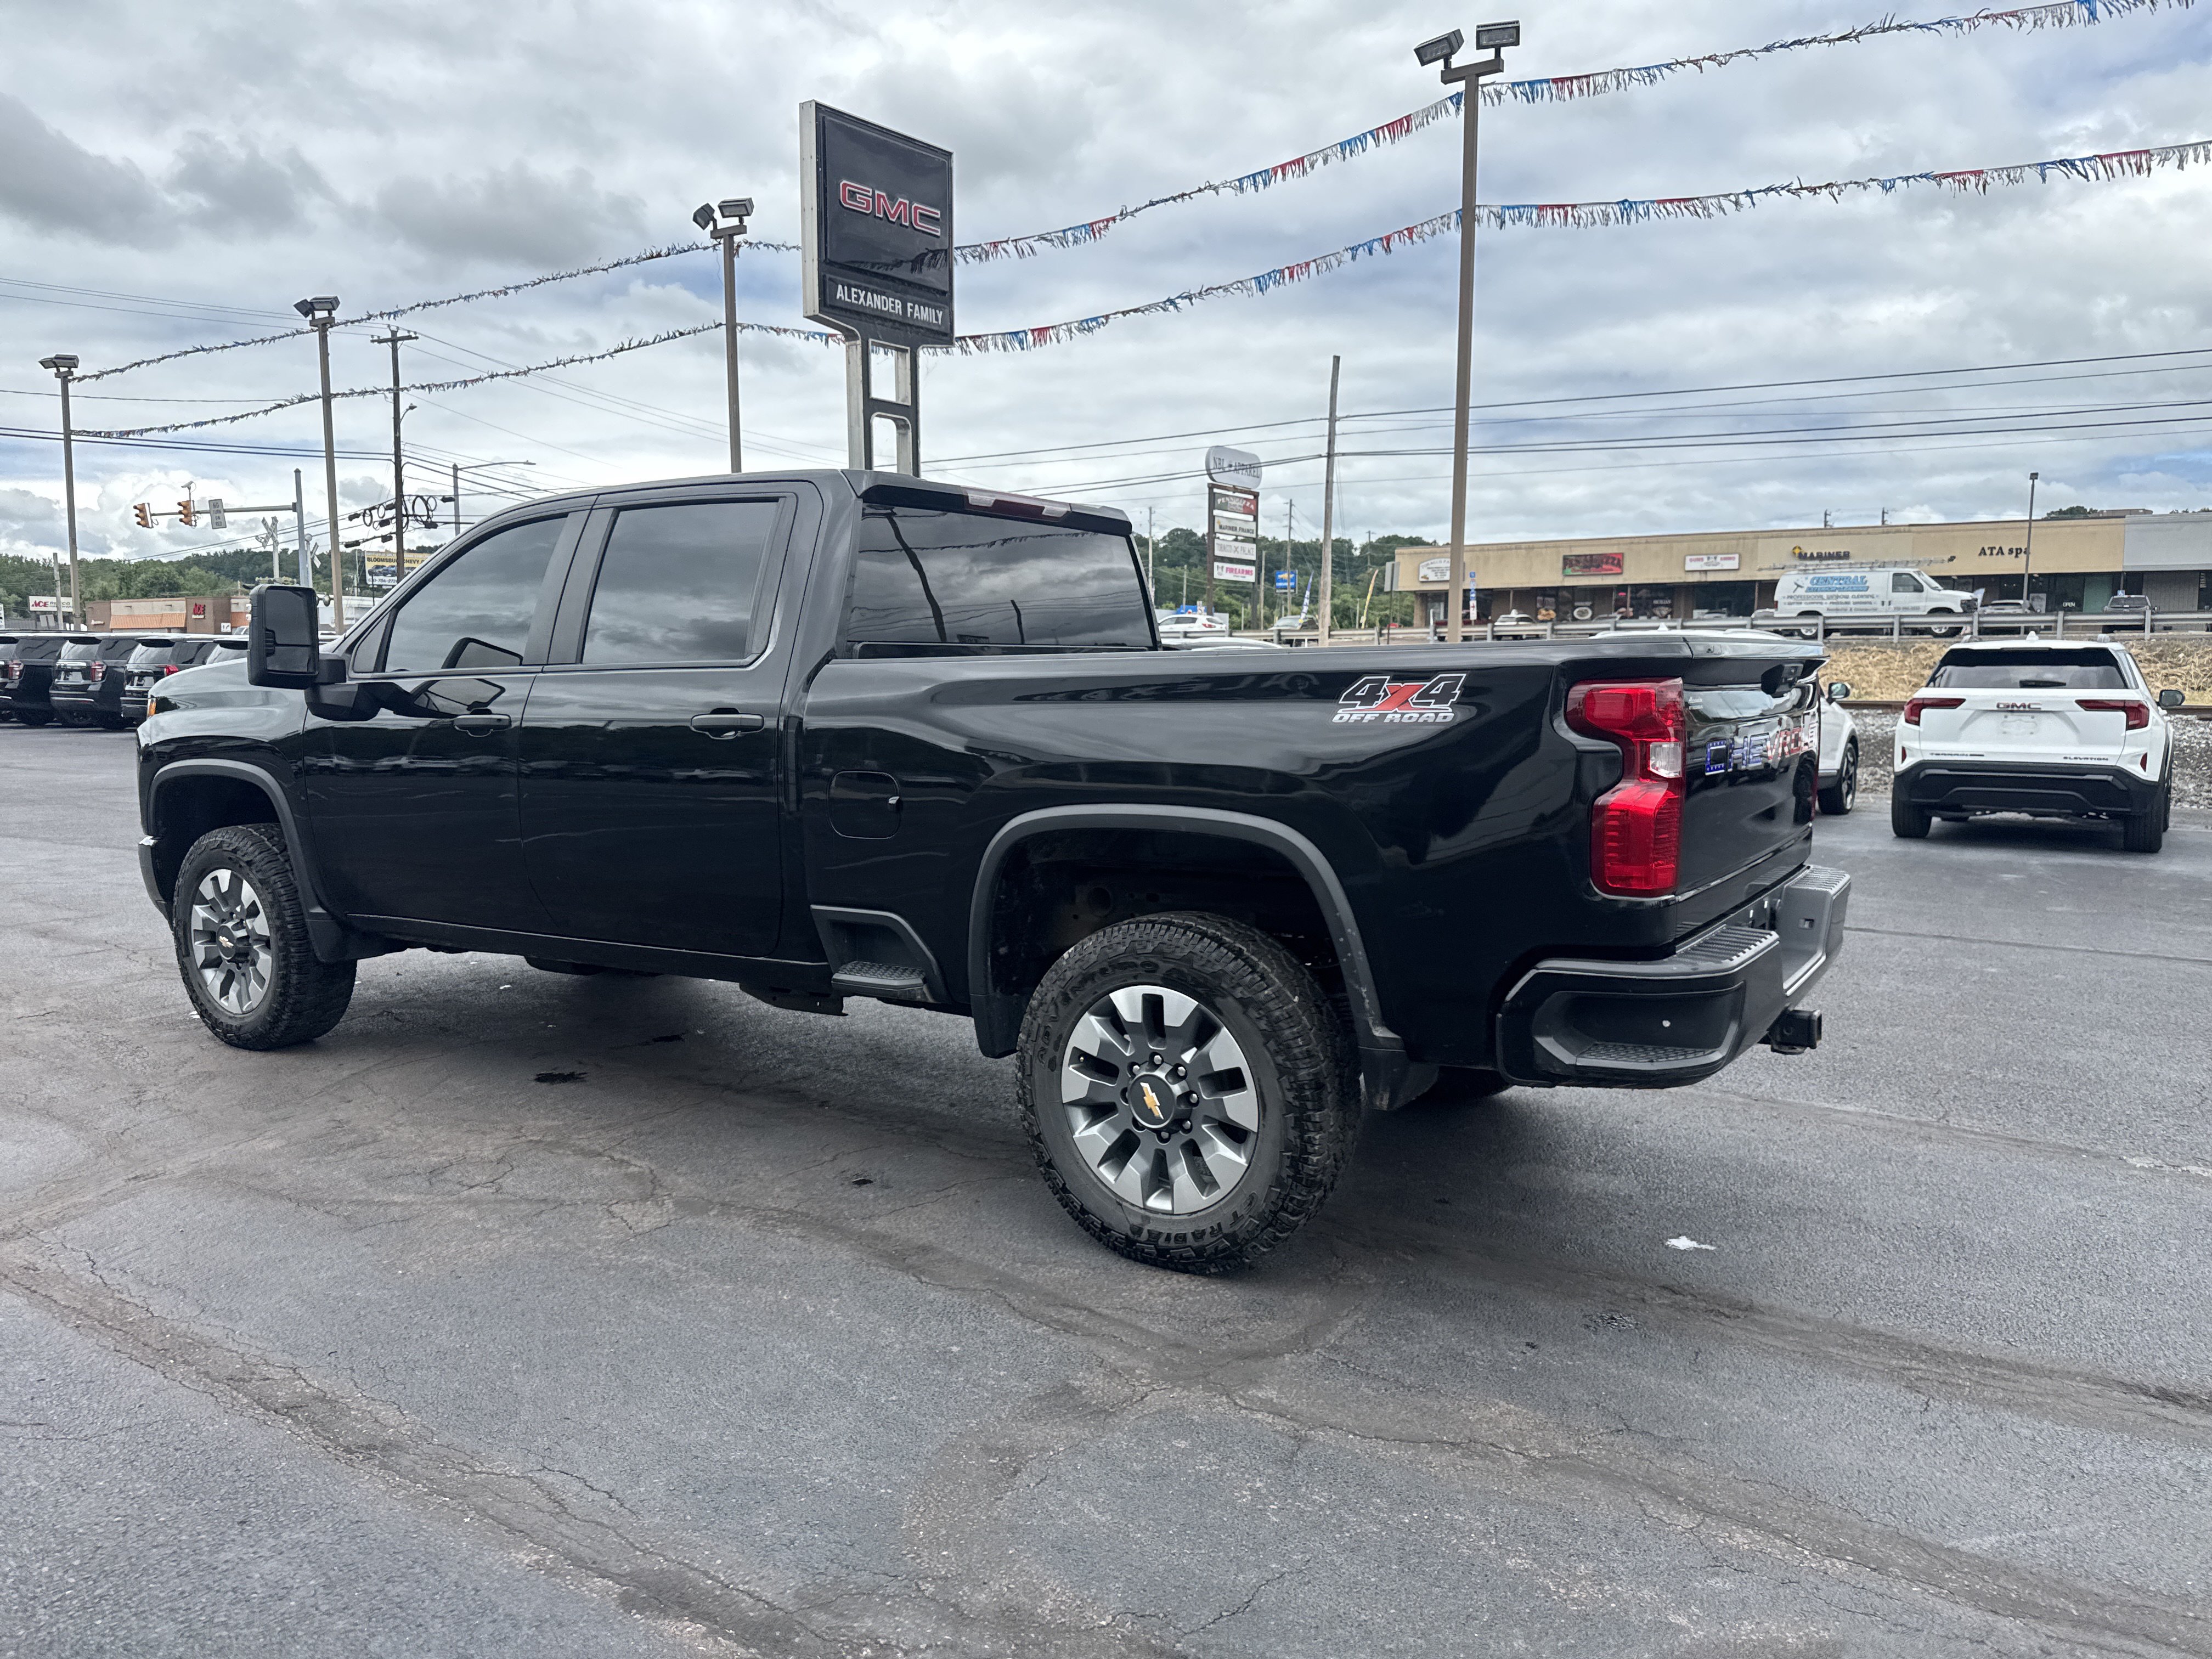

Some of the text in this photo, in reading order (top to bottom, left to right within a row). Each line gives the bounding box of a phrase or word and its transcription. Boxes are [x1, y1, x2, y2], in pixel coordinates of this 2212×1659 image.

[839, 180, 941, 236] GMC
[837, 284, 944, 325] ALEXANDER FAMILY
[1213, 456, 1225, 471] NBL
[1798, 551, 1850, 560] MARINER
[1978, 546, 2005, 556] ATA
[1226, 566, 1254, 576] FIREARMS
[1810, 575, 1867, 586] CENTRAL
[193, 602, 205, 614] ACE
[1332, 713, 1454, 723] OFF ROAD
